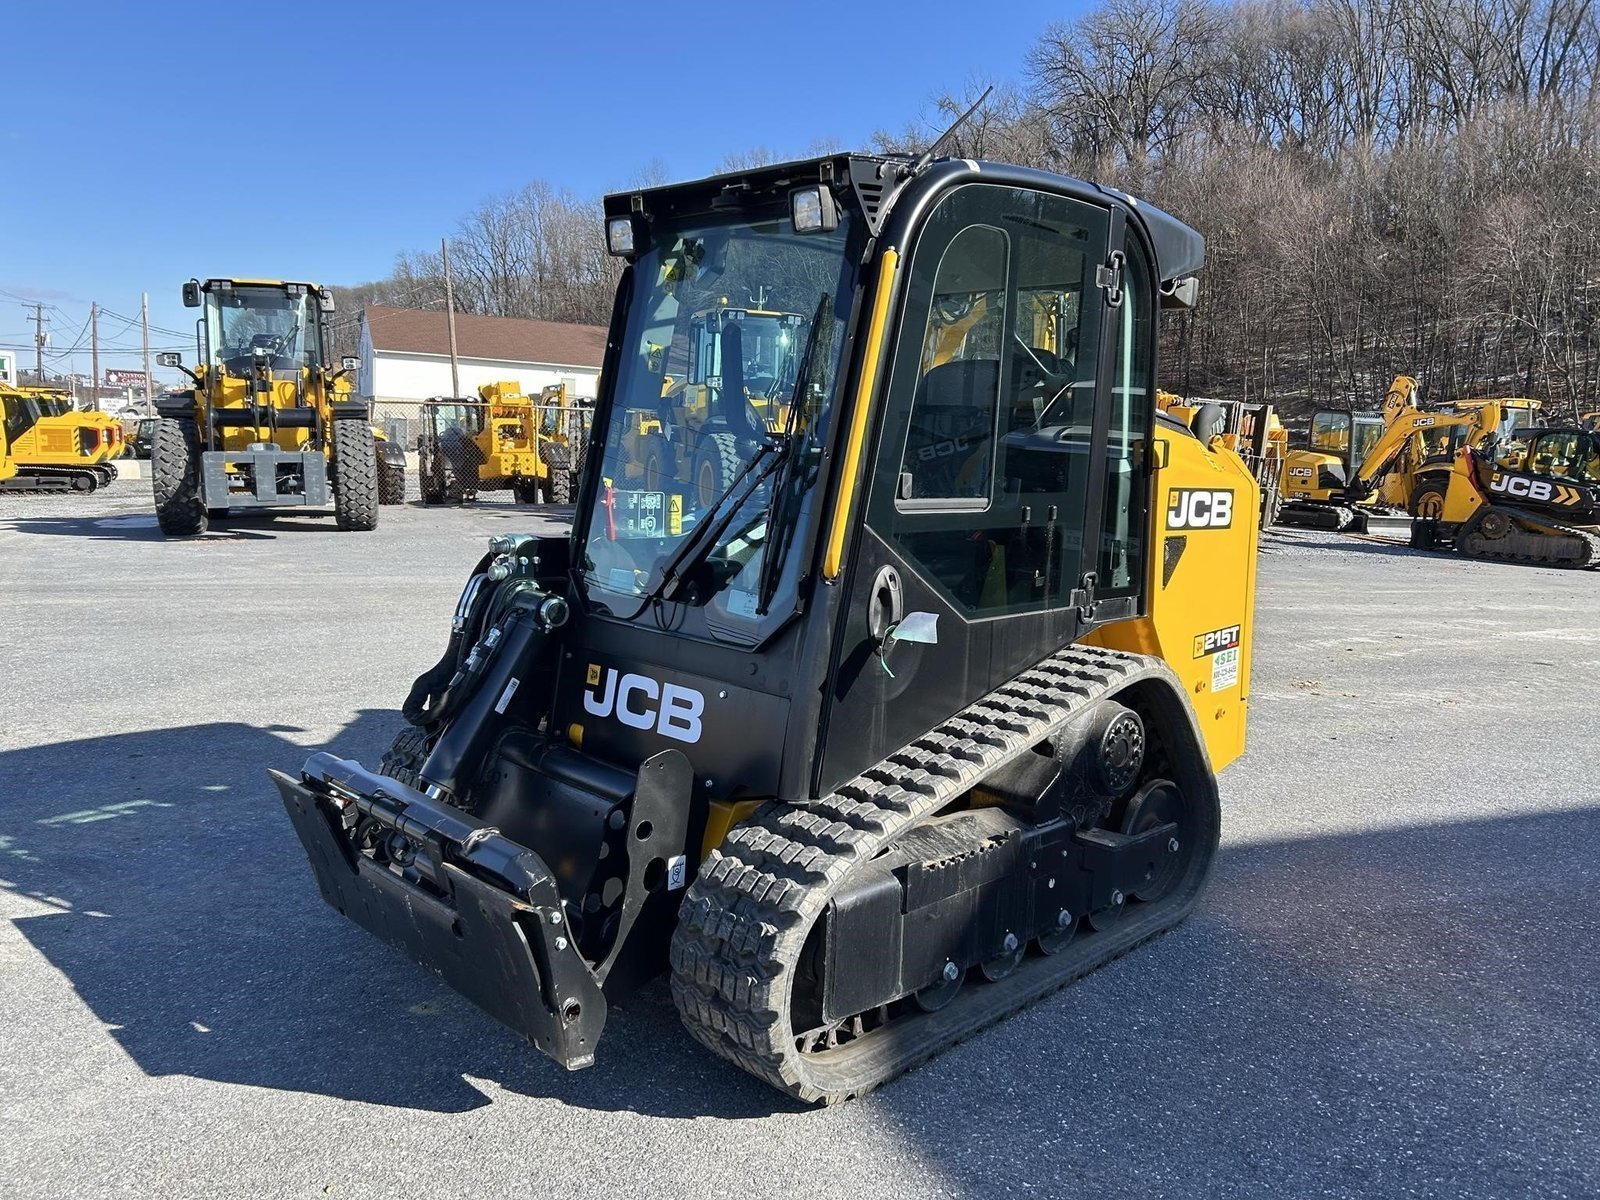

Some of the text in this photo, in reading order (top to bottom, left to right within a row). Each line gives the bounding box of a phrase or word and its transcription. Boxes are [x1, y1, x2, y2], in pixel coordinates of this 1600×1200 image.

[1413, 418, 1435, 427] JCB
[1289, 467, 1312, 477] JCB
[1490, 474, 1552, 501] JCB
[1168, 491, 1232, 527] JCB
[1205, 626, 1239, 650] 215T
[583, 668, 705, 744] JCB
